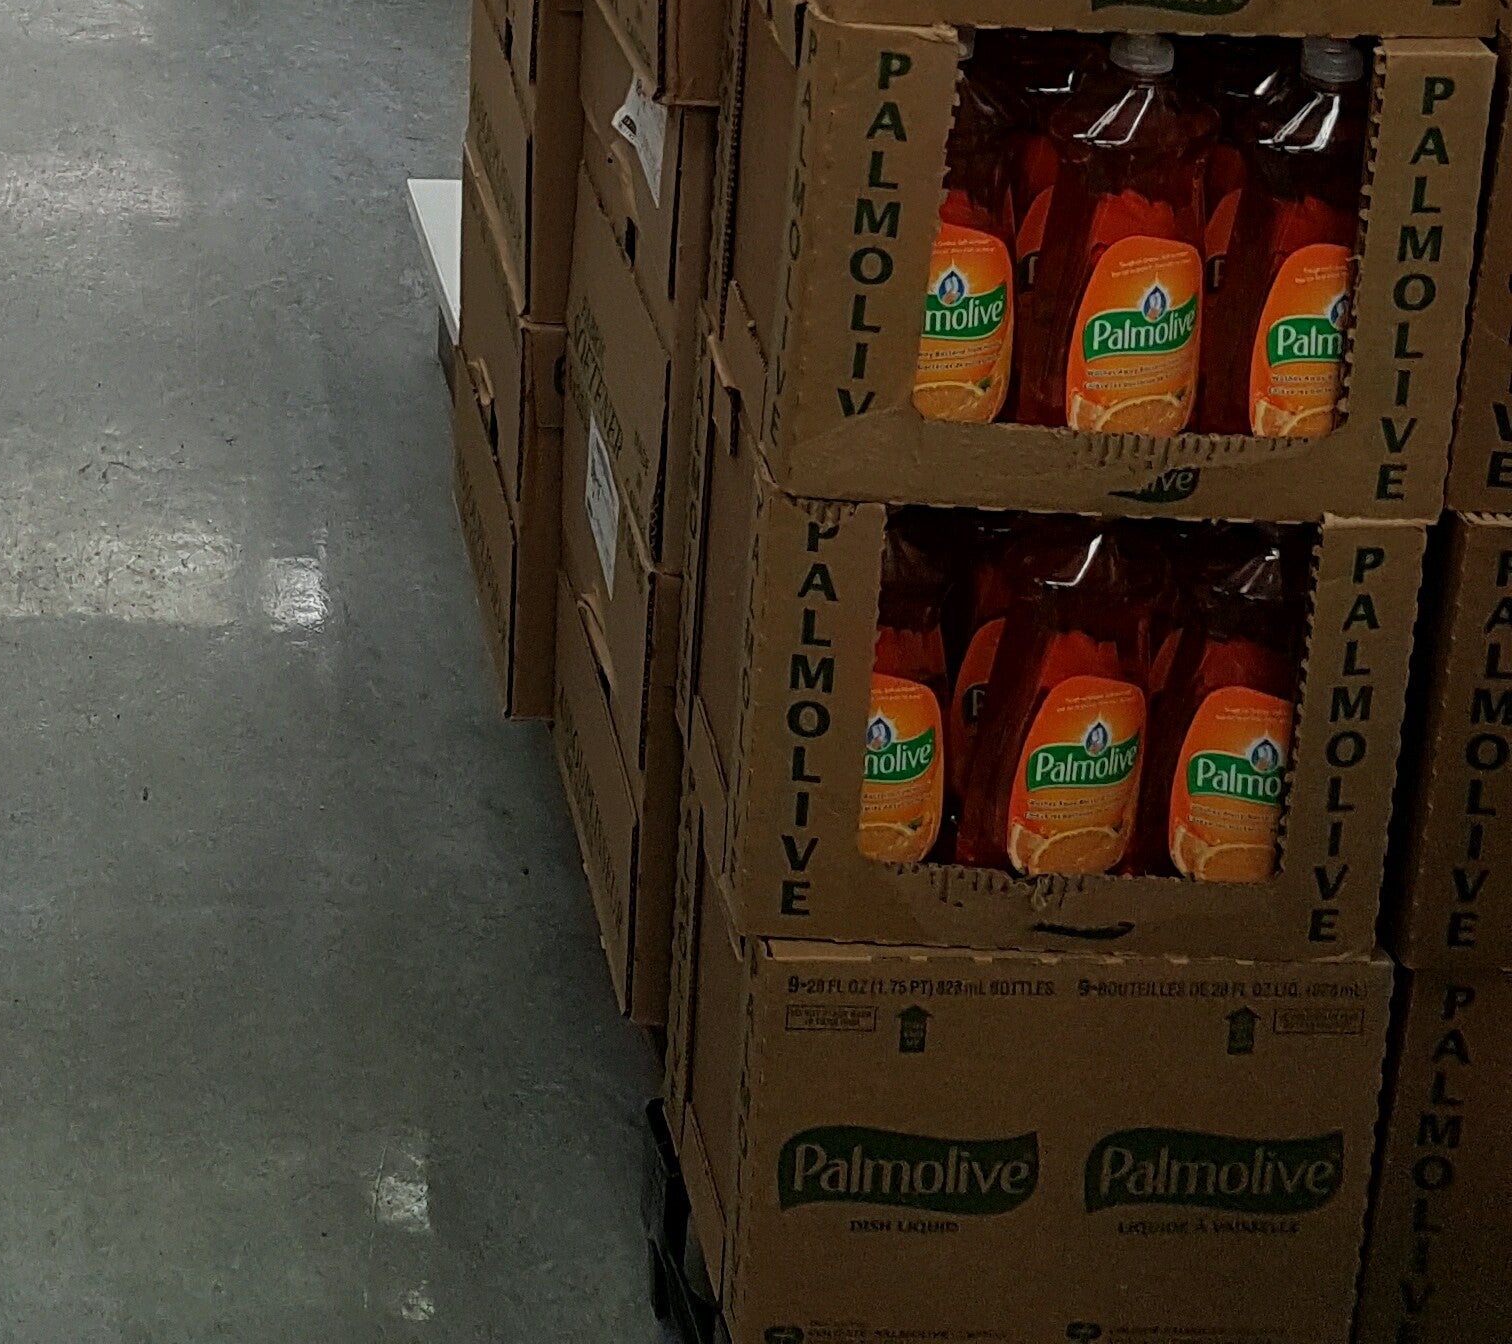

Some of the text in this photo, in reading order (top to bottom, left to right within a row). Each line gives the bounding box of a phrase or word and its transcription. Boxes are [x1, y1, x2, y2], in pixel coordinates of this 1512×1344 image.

[836, 51, 913, 419] PALMOLIV
[1376, 75, 1457, 502] PALMOLIVE
[925, 301, 1005, 333] molive
[1092, 310, 1195, 352] Palmolive
[780, 521, 840, 916] PALMOLIVE
[1308, 546, 1386, 944] PALMOLIVE
[1035, 742, 1137, 786] Palmolive
[1196, 756, 1282, 798] Palmo
[792, 1141, 1033, 1197] Palmolive
[1100, 1145, 1341, 1198] Palmolive
[849, 1218, 890, 1234] DISH
